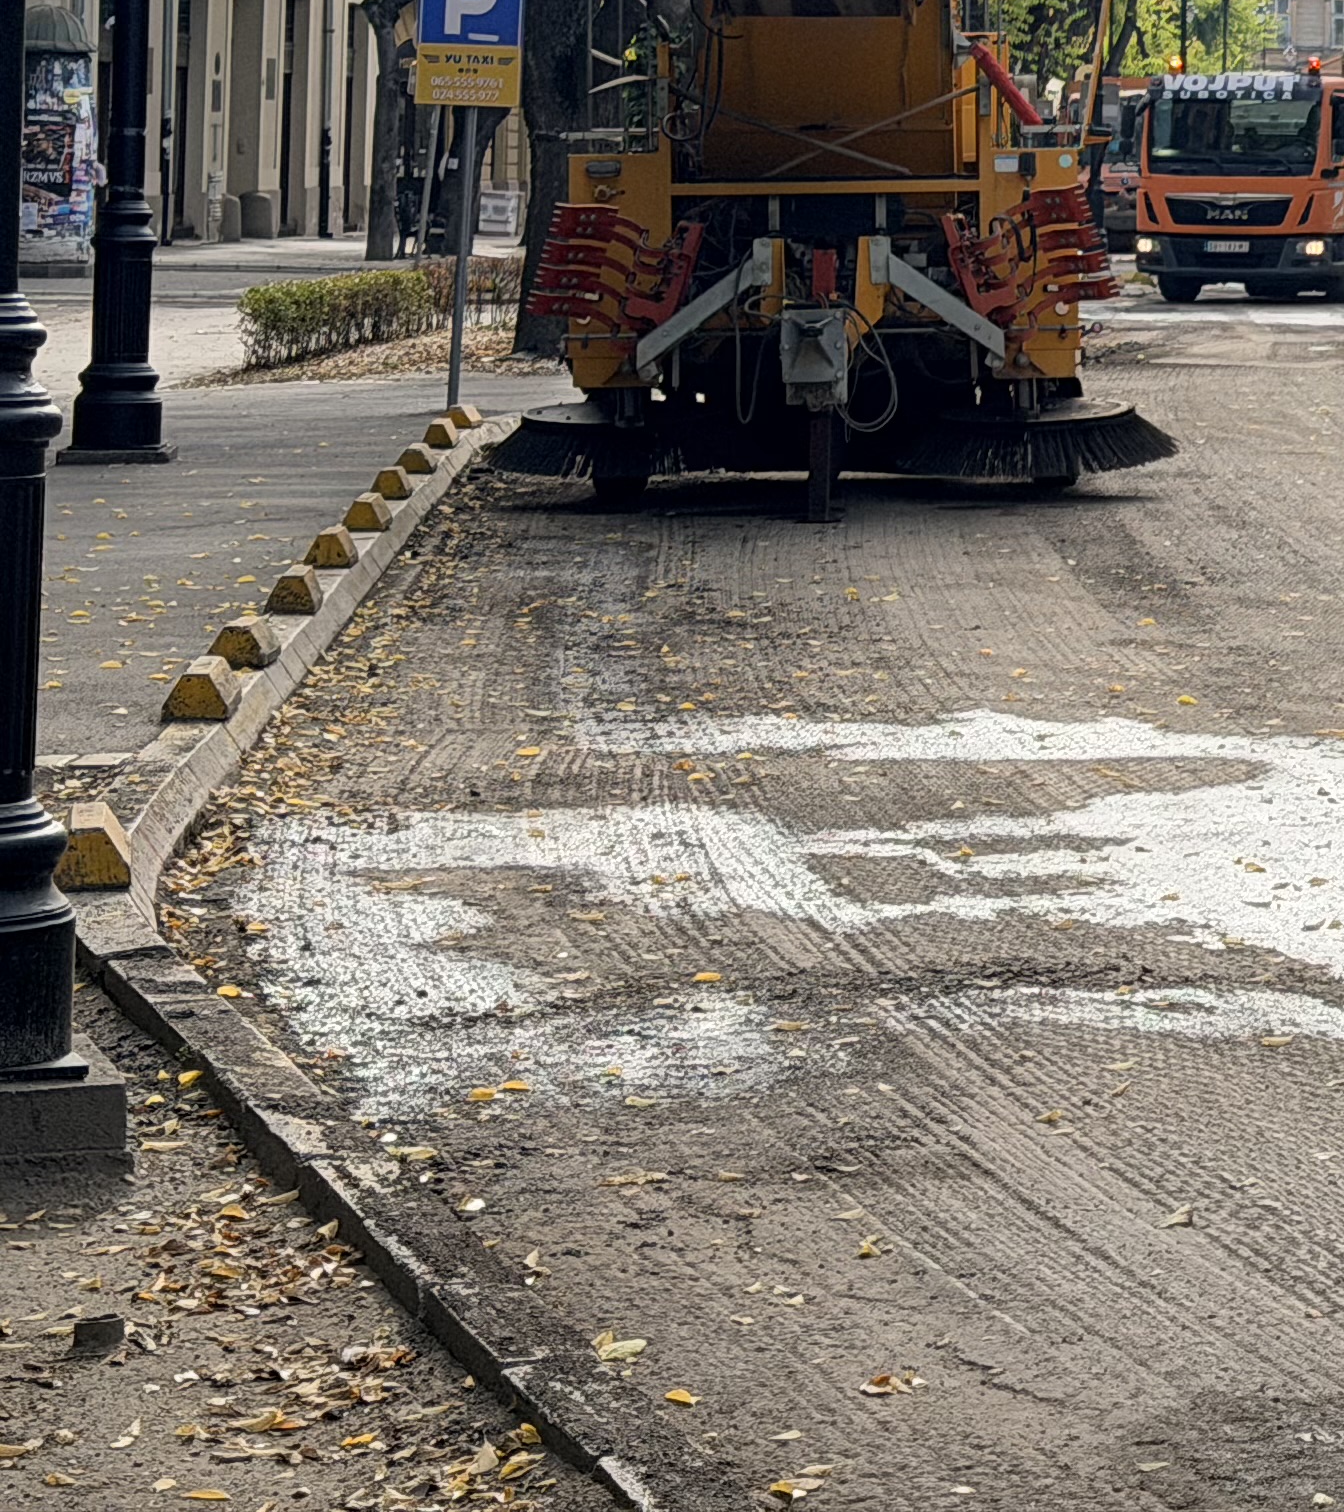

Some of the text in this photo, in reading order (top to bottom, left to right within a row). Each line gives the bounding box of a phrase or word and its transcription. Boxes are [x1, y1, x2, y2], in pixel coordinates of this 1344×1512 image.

[444, 54, 494, 65] YU TAXI
[1164, 74, 1300, 91] VOJPUT
[1162, 90, 1293, 100] SUBOTICA
[1206, 209, 1249, 220] MAN
